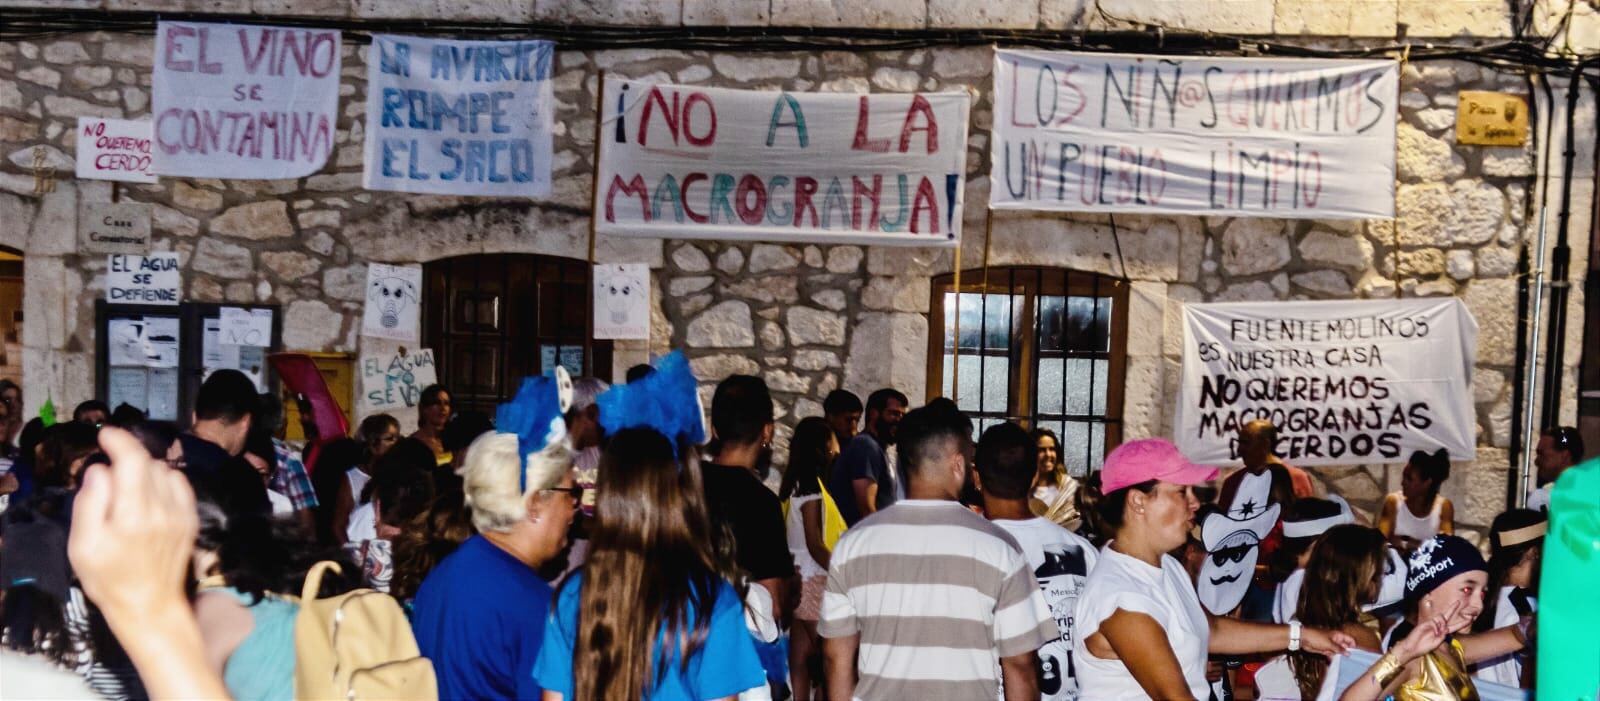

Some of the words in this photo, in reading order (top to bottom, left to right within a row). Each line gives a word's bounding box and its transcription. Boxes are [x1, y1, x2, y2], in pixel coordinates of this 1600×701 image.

[166, 26, 222, 75] EL
[238, 28, 335, 78] VINO
[378, 41, 410, 77] LA
[234, 84, 262, 101] SE
[1011, 60, 1087, 128] LOS
[1227, 71, 1385, 134] QUEREMOS
[381, 87, 514, 133] ROMPE
[766, 92, 809, 148] A
[851, 94, 939, 154] LA
[84, 122, 105, 137] NO
[156, 107, 331, 162] CONTAMINA
[96, 136, 152, 154] QUEREMO
[96, 154, 154, 176] CERDO
[382, 139, 430, 180] EL
[440, 138, 534, 182] SACO
[1006, 139, 1045, 200] UN
[1058, 142, 1166, 206] PUEBLO
[1210, 141, 1322, 209] LIMPIO
[605, 172, 960, 241] MACROGRANJA!
[112, 254, 131, 272] EL
[140, 257, 178, 271] AGUA
[132, 274, 152, 285] SE
[111, 287, 176, 301] DEFIENDE
[365, 357, 383, 377] EL
[388, 351, 434, 372] AGUA
[1200, 342, 1221, 362] es
[1227, 348, 1315, 372] NUESTRA
[1325, 344, 1382, 368] CASA
[368, 388, 395, 407] SE
[399, 384, 425, 408] VEN
[1199, 374, 1241, 408] NO
[1245, 374, 1390, 404] QUEREMOS
[1273, 433, 1403, 459] CERDOS
[1054, 614, 1074, 628] rip
